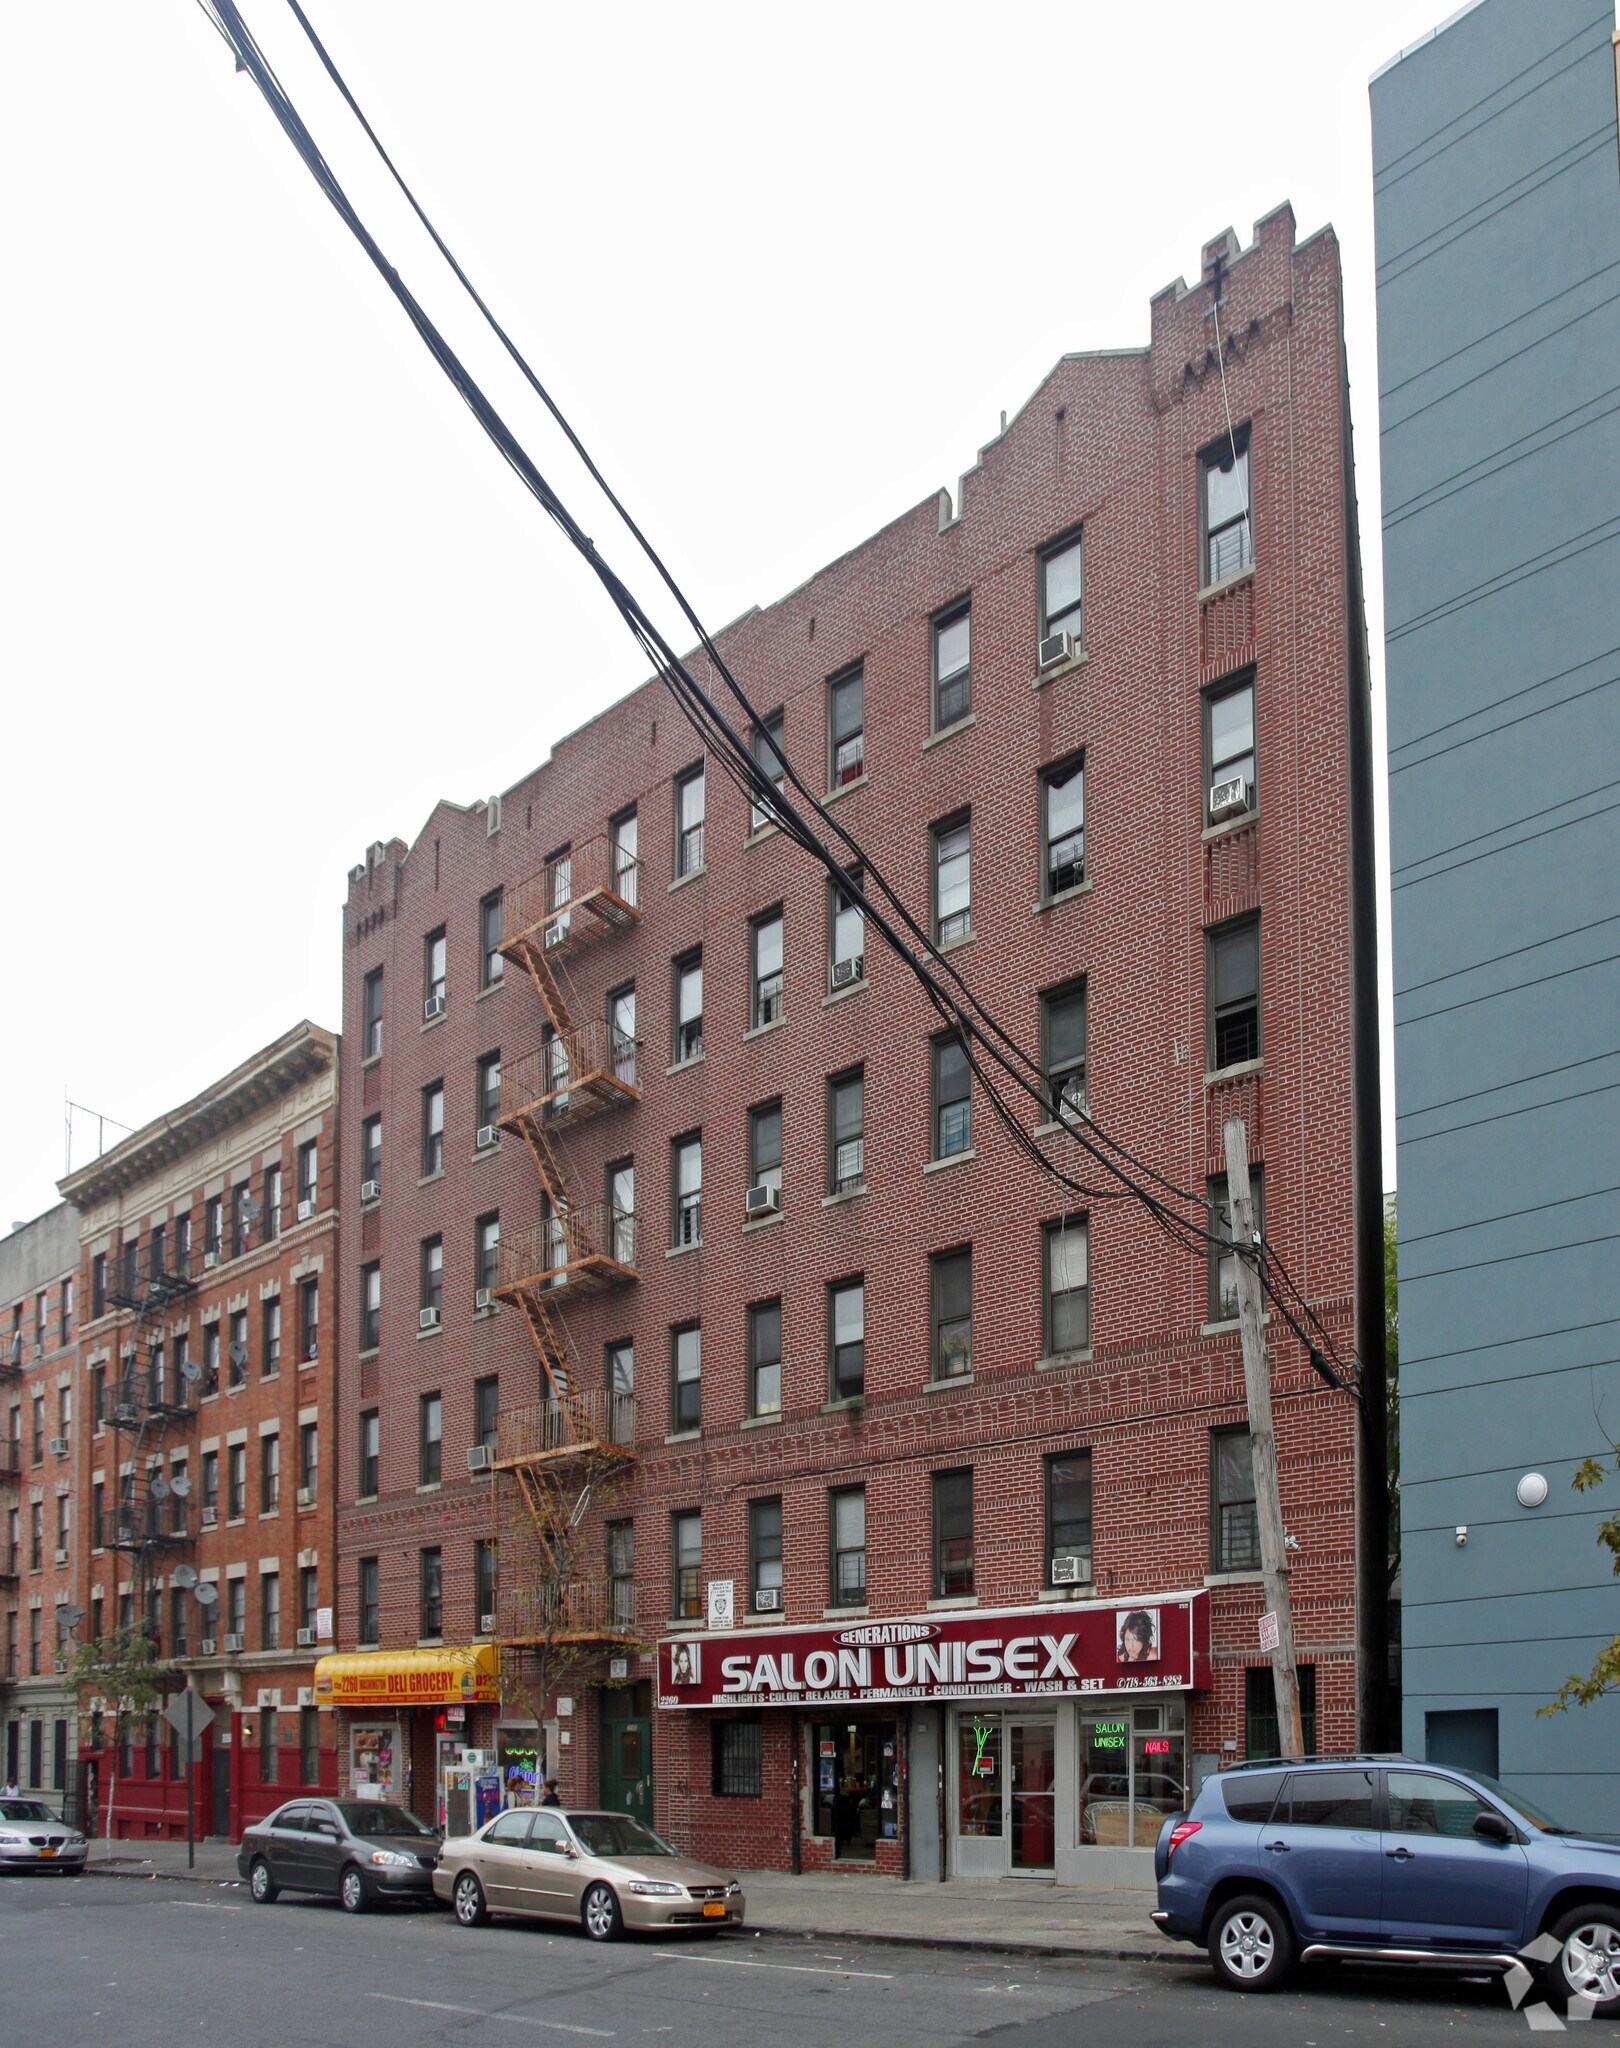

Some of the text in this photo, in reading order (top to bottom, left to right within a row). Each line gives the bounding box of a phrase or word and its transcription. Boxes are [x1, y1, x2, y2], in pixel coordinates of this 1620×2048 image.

[840, 1624, 931, 1644] GENERATIONS
[721, 1633, 1080, 1692] SALON UNISEX
[342, 1675, 358, 1693] 2260
[388, 1674, 407, 1693] DELI
[409, 1672, 454, 1692] GROCERY
[712, 1678, 1105, 1704] HIGHLIGHTS COLOR RELAXER PERMANENT CONDITIONER WASH & SET
[659, 1695, 679, 1705] 2260
[1095, 1723, 1125, 1734] SALON
[1094, 1737, 1125, 1748] UNISEX
[1144, 1740, 1170, 1754] NAILS
